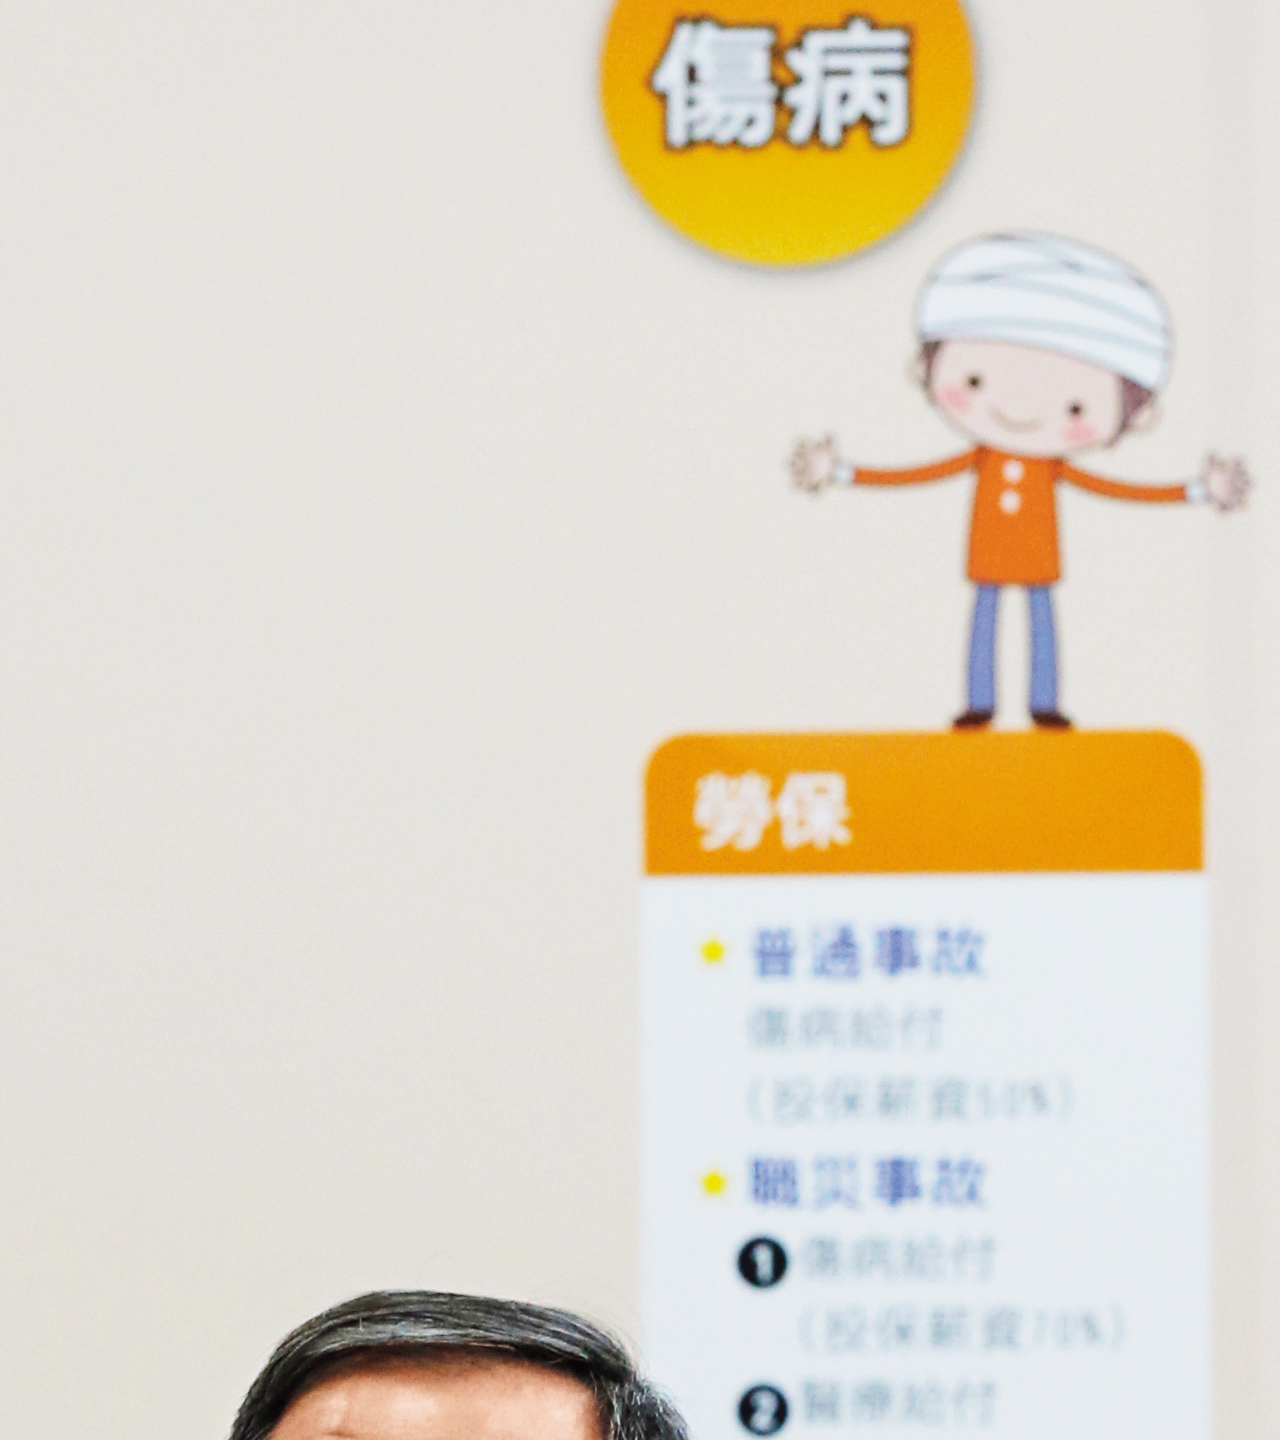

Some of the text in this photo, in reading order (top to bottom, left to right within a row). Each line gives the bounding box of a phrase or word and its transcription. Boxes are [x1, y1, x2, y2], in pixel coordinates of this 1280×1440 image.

[650, 16, 912, 150] 傷病
[693, 771, 852, 851] 勞保
[751, 923, 986, 981] 普通事故
[747, 1153, 986, 1211] 職災事故
